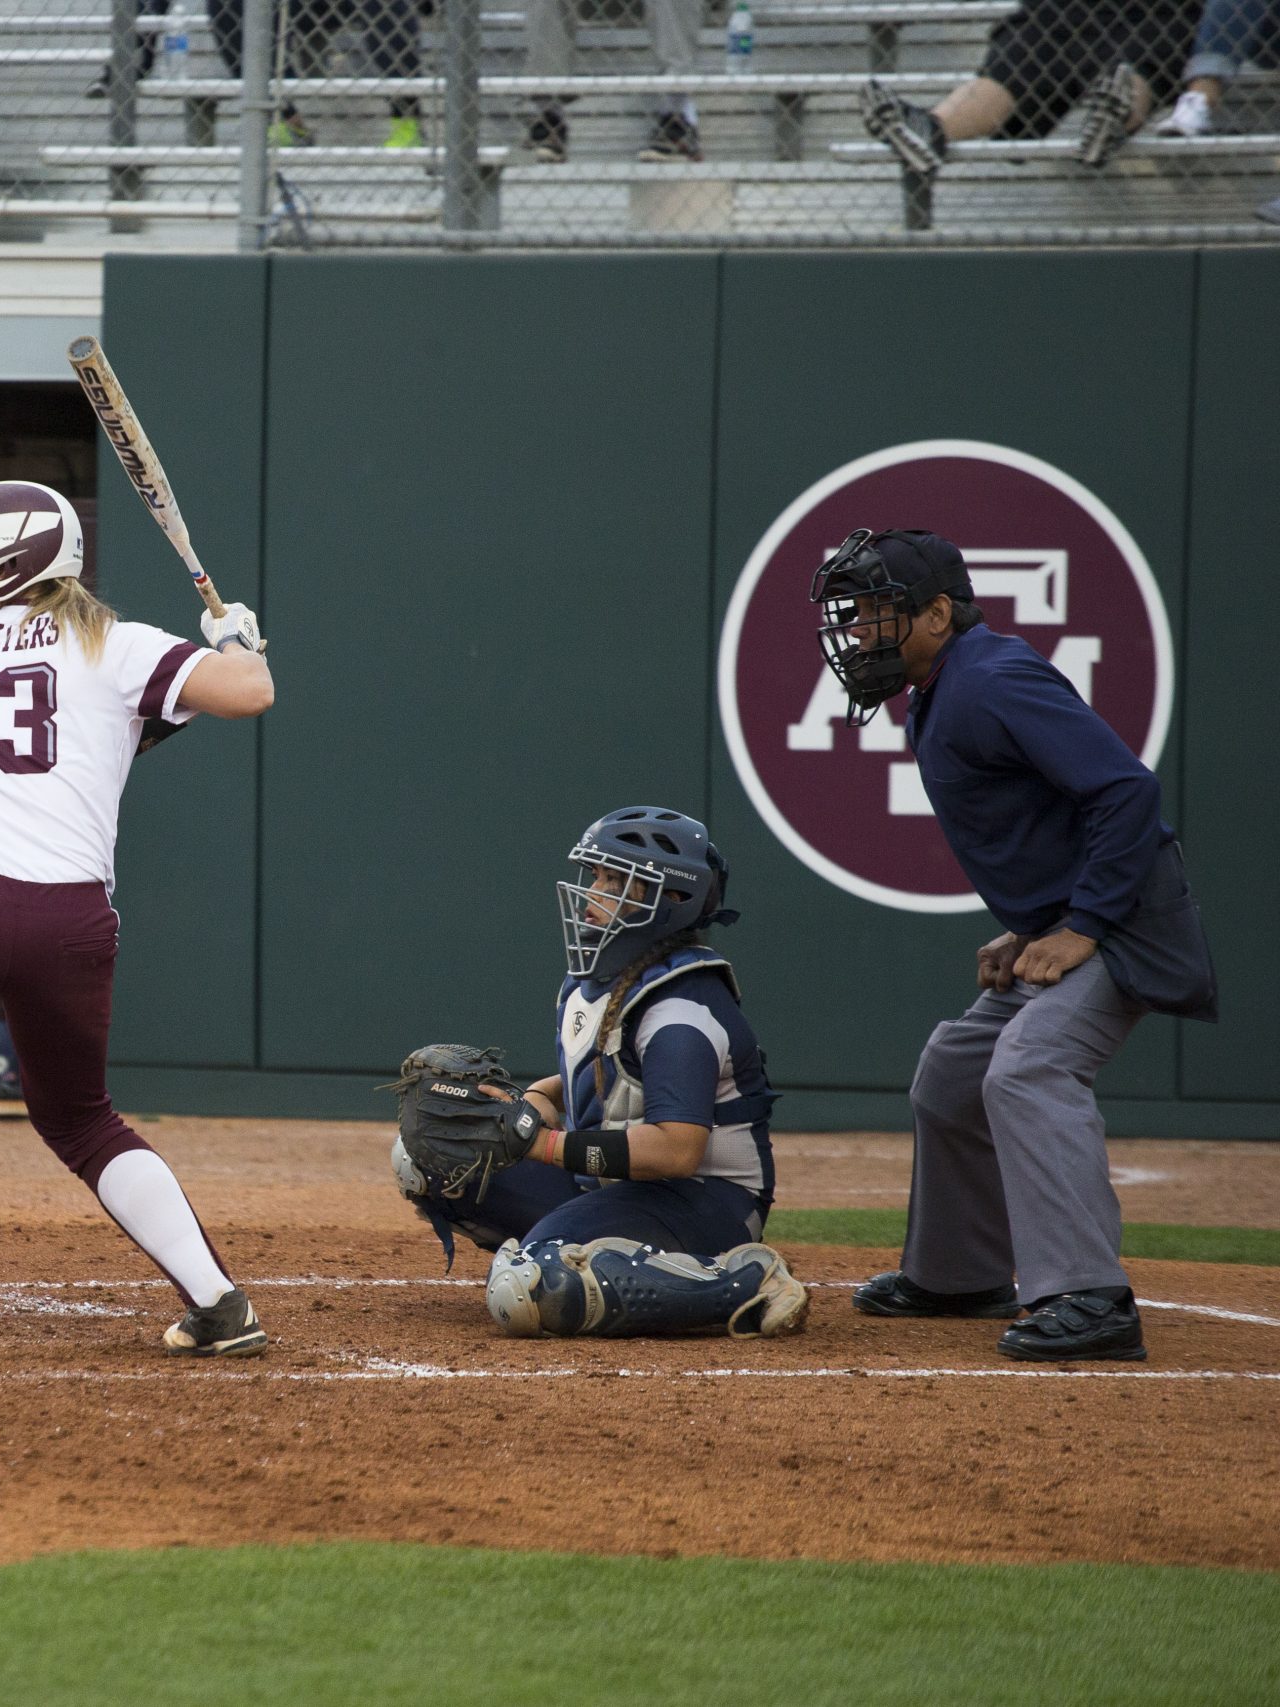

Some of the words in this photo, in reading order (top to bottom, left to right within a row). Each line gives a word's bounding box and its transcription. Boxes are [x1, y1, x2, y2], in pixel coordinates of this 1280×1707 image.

[76, 365, 166, 511] RAWLINGS
[663, 866, 698, 882] LOUISVILLE
[430, 1082, 469, 1098] A2000
